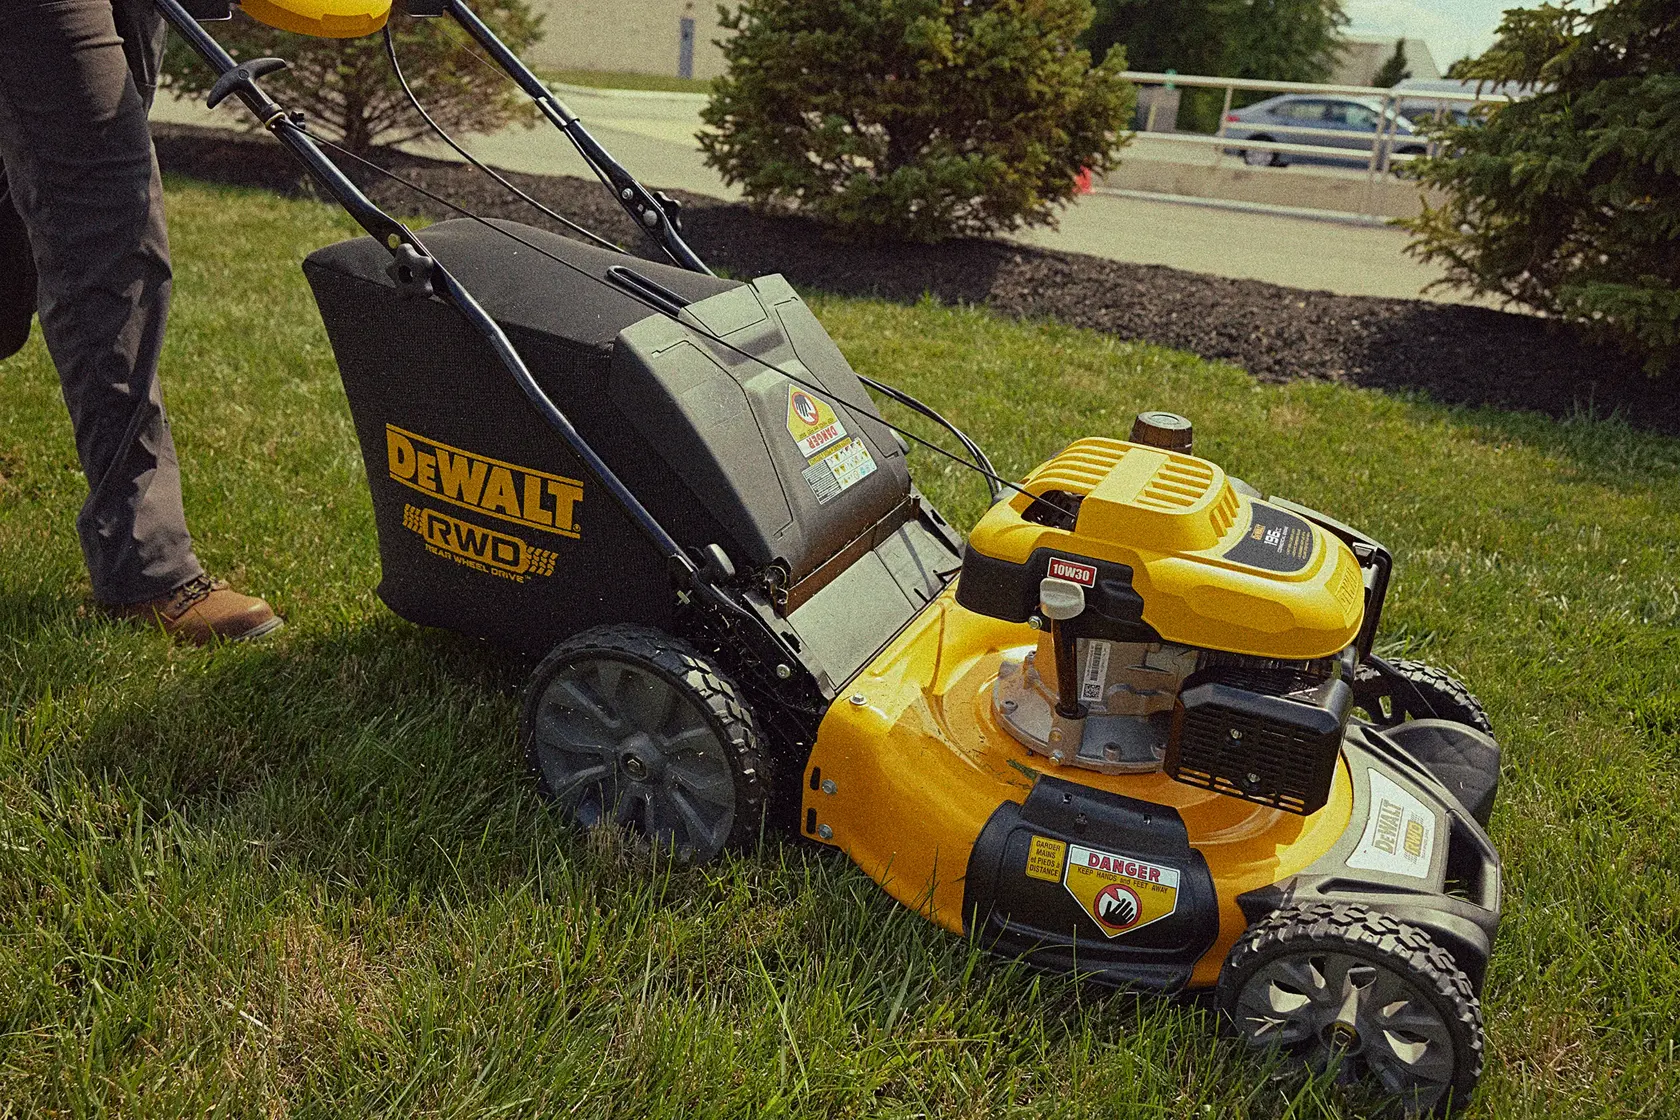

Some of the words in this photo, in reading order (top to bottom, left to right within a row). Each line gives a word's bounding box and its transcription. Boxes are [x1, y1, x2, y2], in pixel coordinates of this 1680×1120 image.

[807, 425, 838, 449] DANGER
[427, 514, 521, 567] RWD
[425, 543, 452, 560] REAR
[453, 554, 489, 573] WHEEL
[1053, 563, 1090, 581] 10W30
[1035, 840, 1061, 852] GARDER
[1035, 849, 1056, 859] MAINS
[1029, 864, 1059, 877] DISTANCE
[1037, 857, 1055, 868] PIEDS
[1088, 853, 1161, 882] DANGER
[1077, 866, 1094, 876] KEEP
[1096, 870, 1118, 882] HANDS
[1133, 879, 1148, 889] FEET
[1151, 884, 1169, 894] AWAY
